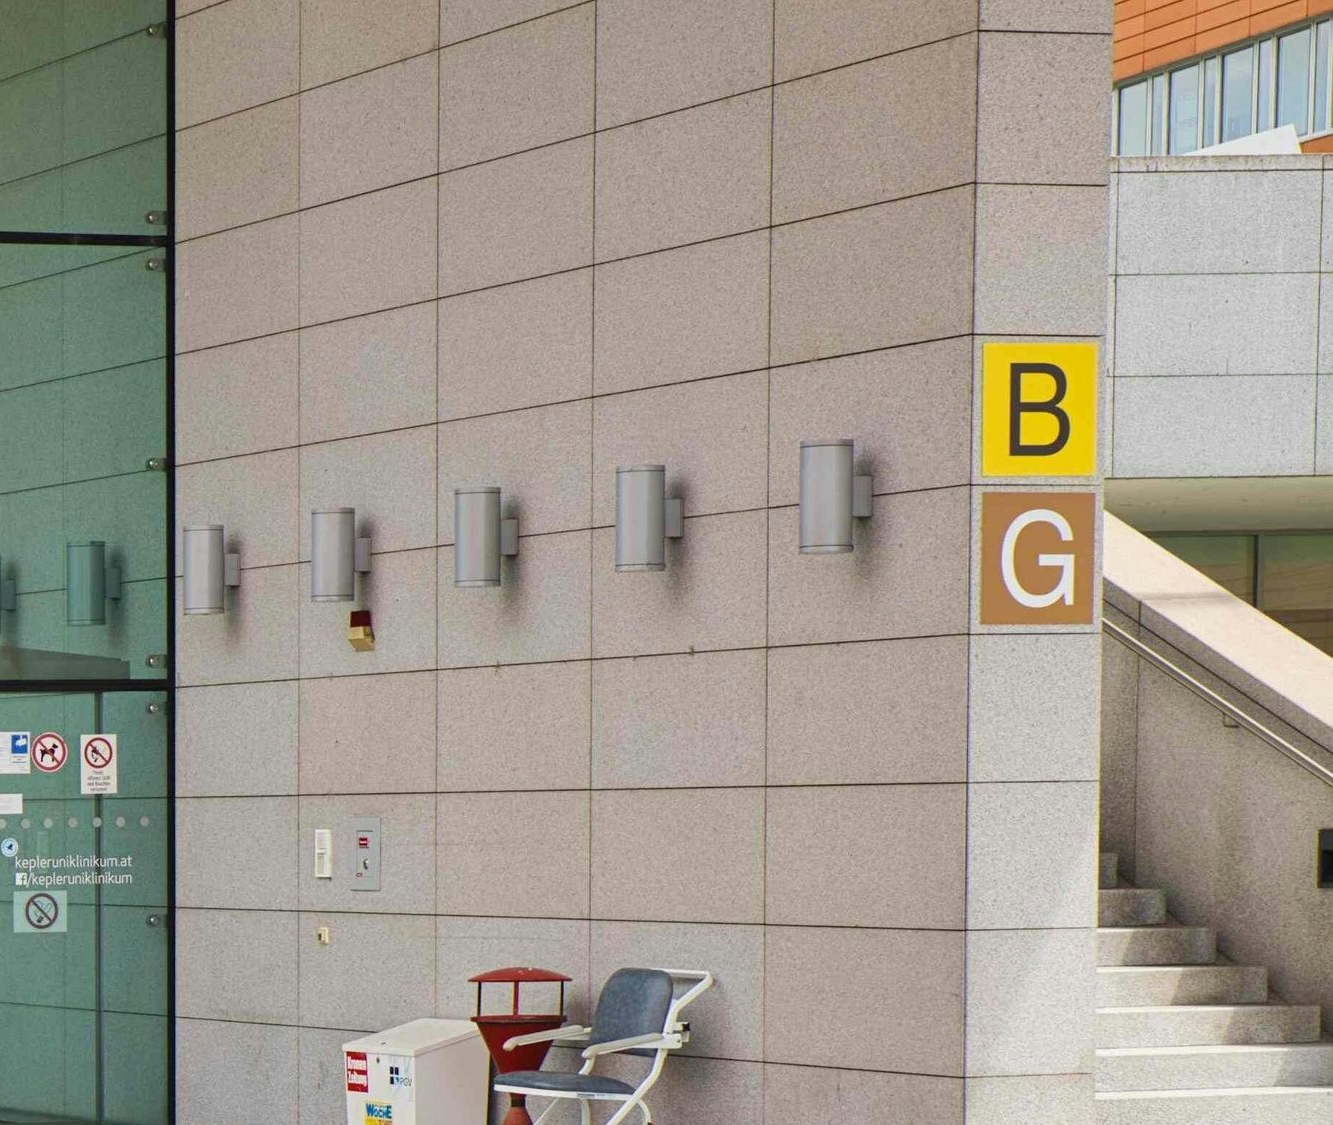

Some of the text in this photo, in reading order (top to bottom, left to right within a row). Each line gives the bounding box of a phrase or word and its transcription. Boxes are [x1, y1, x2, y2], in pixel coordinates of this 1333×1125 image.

[1008, 362, 1071, 456] B
[1000, 508, 1075, 609] G
[15, 855, 132, 872] kepleruniklinikum.at
